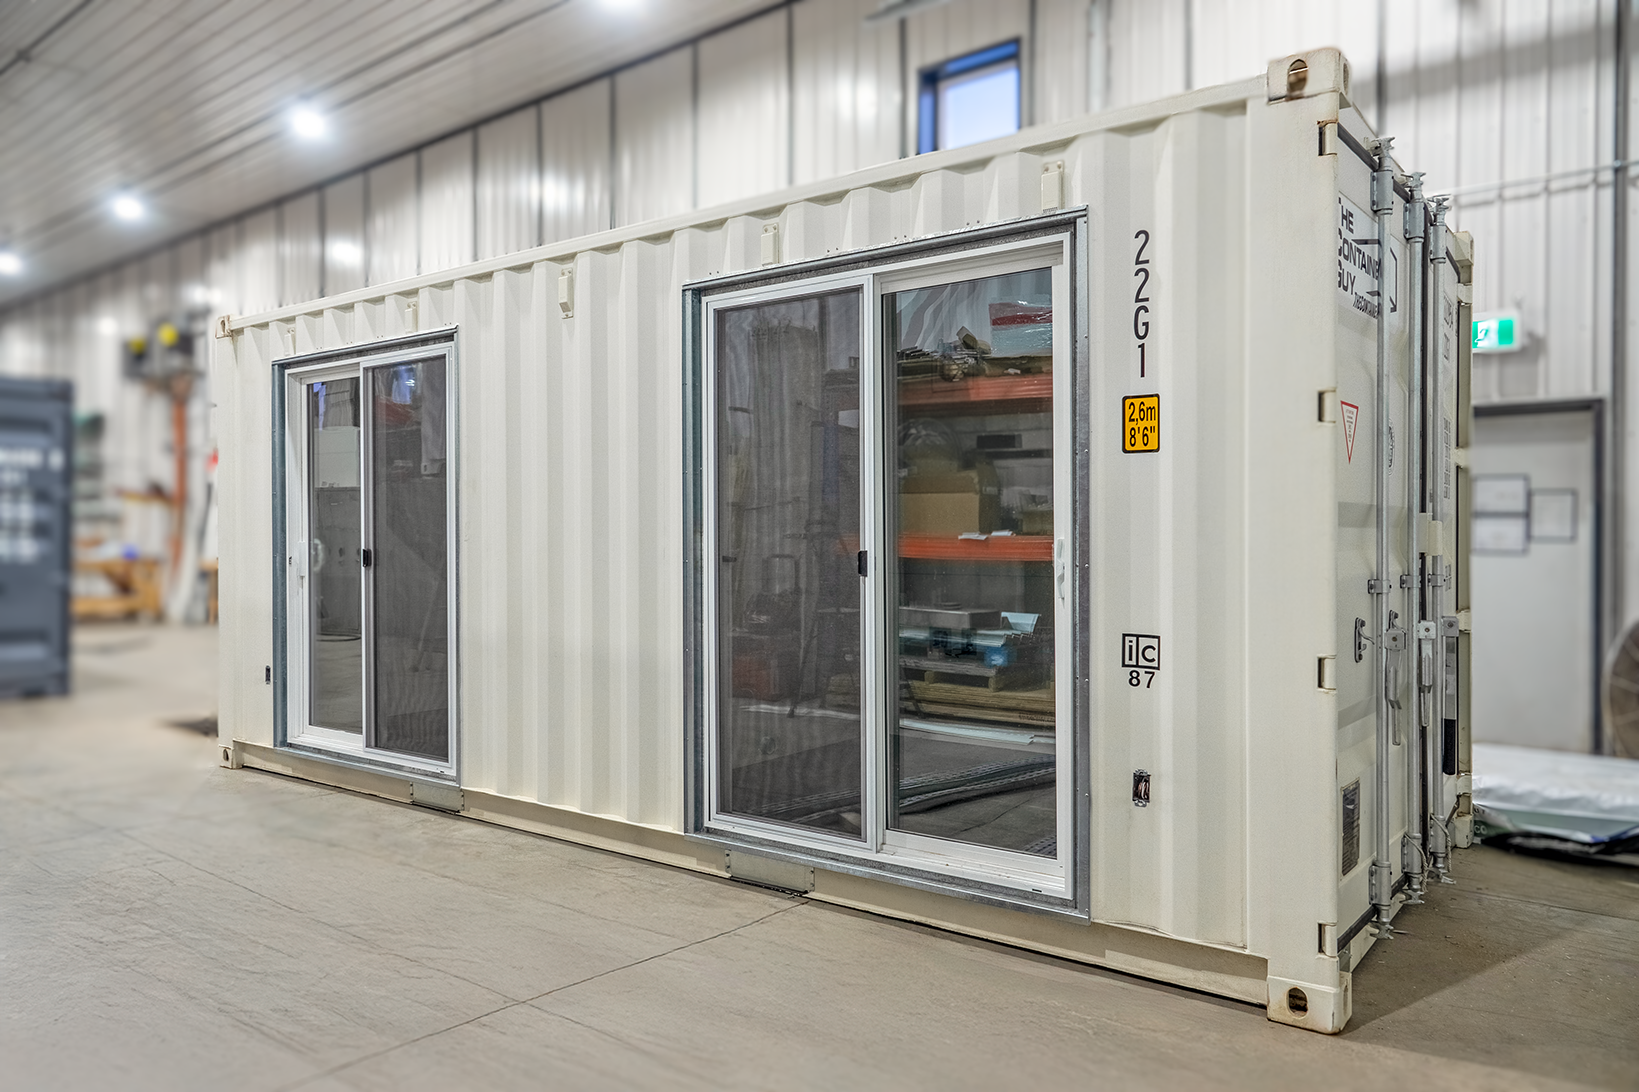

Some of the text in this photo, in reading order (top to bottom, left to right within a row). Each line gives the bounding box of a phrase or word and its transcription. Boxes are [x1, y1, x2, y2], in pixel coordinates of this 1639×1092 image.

[1133, 229, 1151, 378] 22G1
[1128, 401, 1156, 425] 2,6m
[1129, 426, 1156, 447] 8'6"
[1128, 669, 1156, 688] 87
